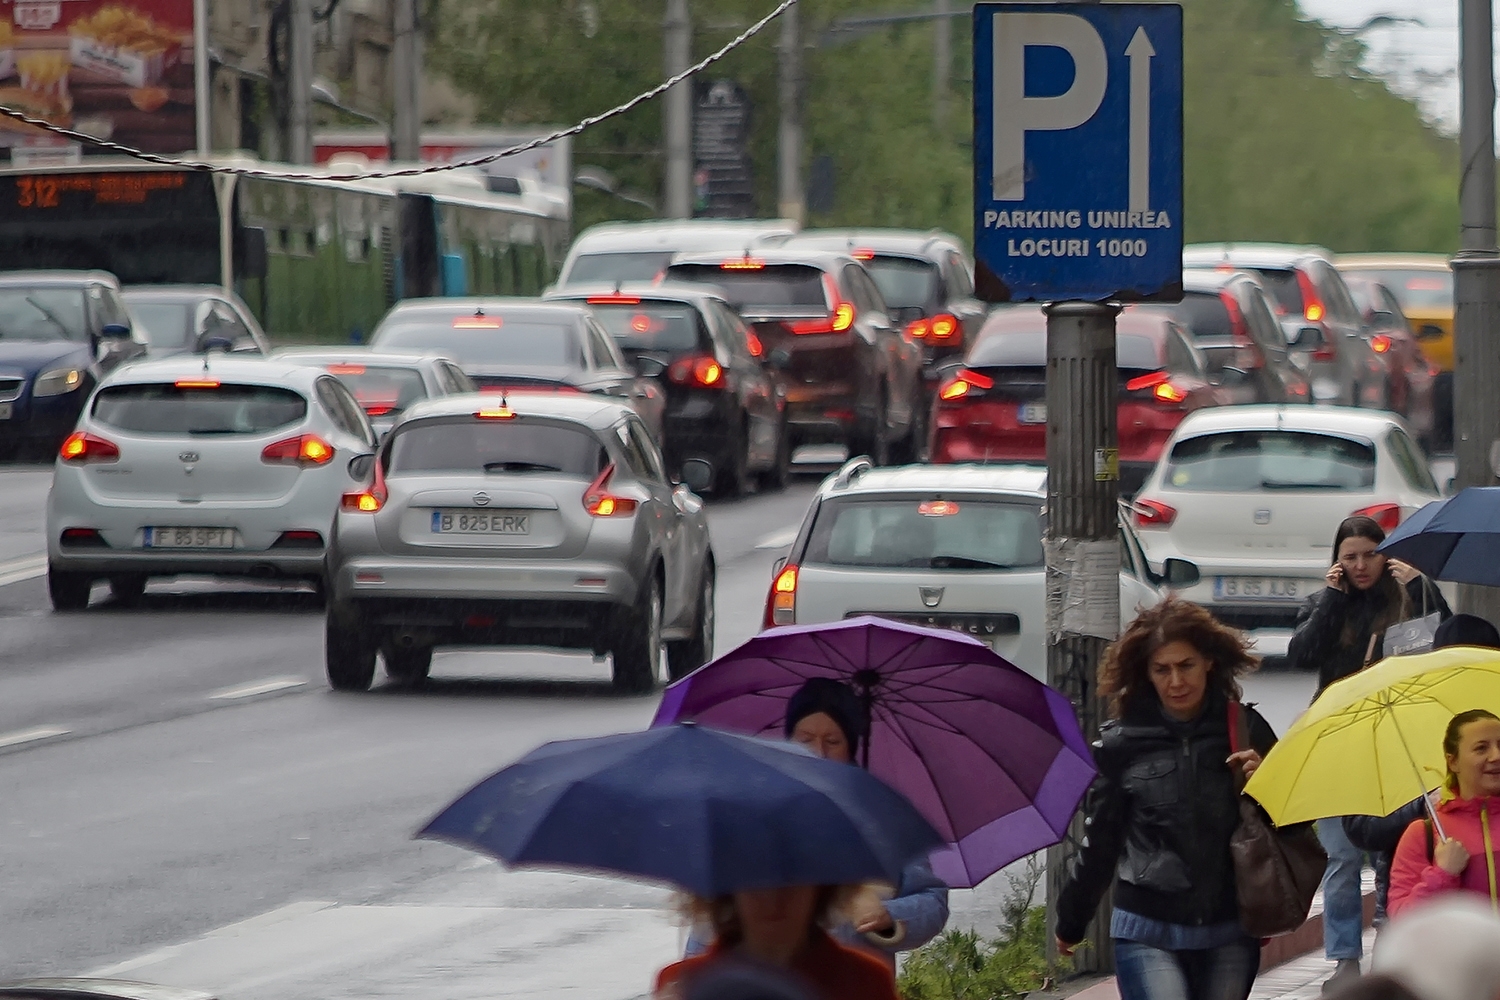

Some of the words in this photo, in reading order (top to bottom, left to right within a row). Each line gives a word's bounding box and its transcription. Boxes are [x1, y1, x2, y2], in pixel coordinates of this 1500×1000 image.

[993, 13, 1108, 201] P
[16, 176, 58, 208] 312
[984, 211, 1081, 229] PARKING
[1087, 211, 1172, 229] UNIREA
[1007, 238, 1090, 257] LOCURI
[1096, 238, 1148, 257] 1000
[441, 515, 453, 531] B
[459, 515, 488, 531] 825
[491, 516, 527, 532] ERK
